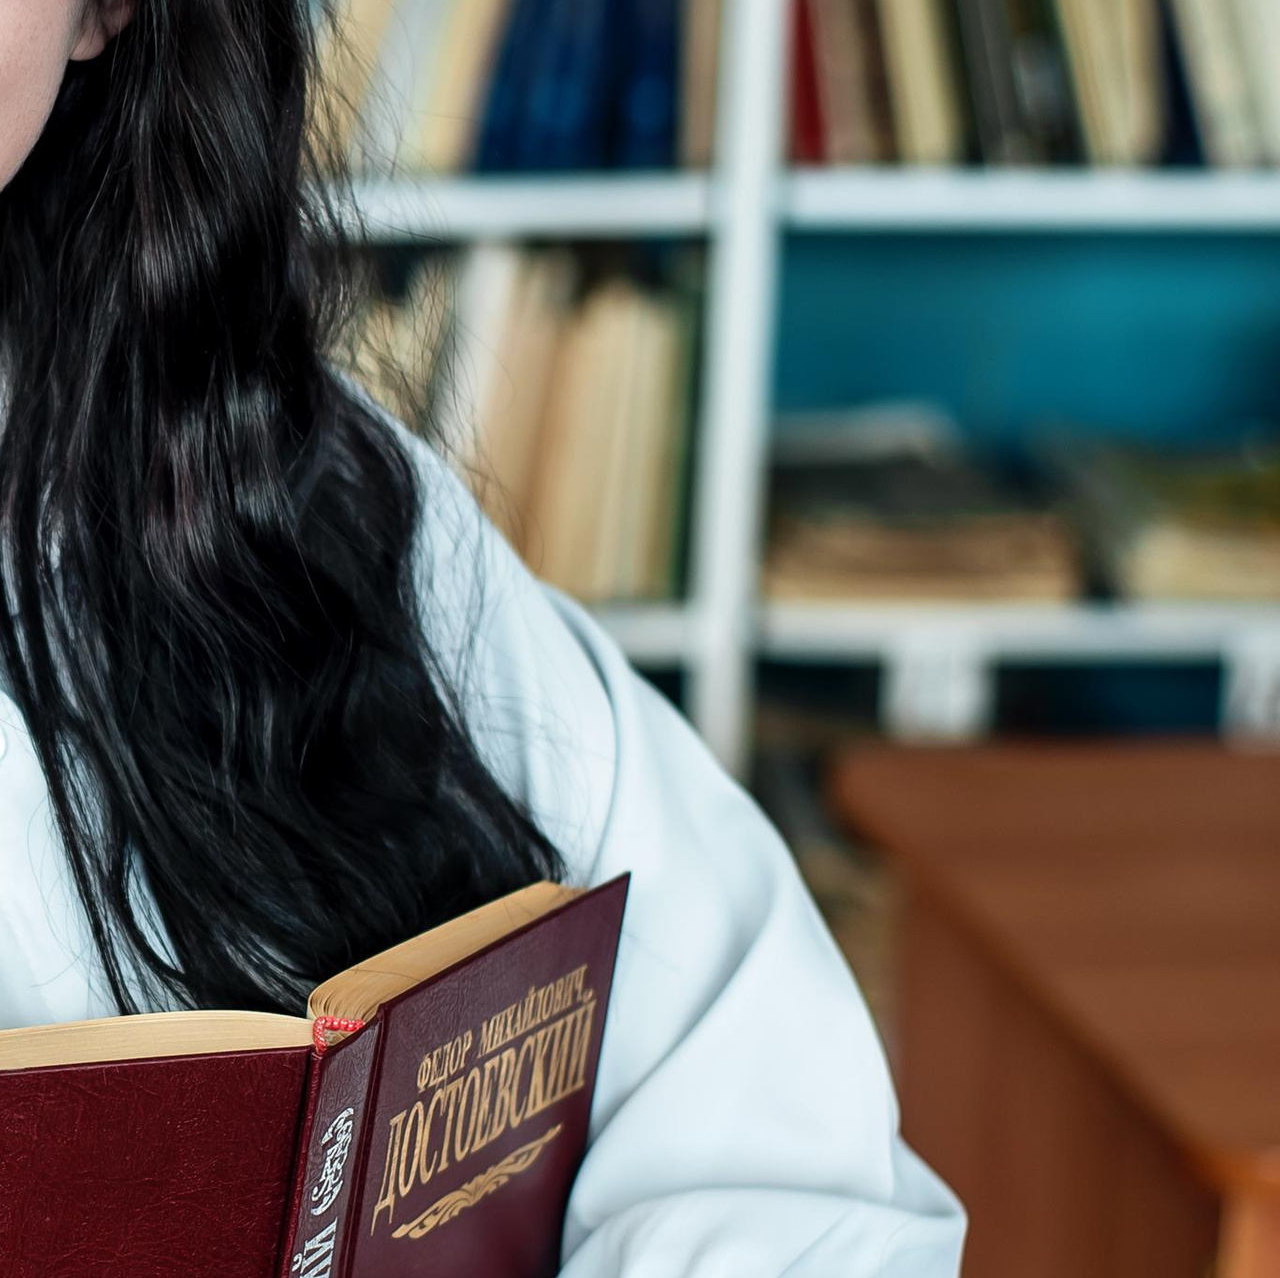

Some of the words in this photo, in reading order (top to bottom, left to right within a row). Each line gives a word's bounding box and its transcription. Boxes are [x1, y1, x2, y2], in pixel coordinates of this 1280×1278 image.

[371, 988, 596, 1236] ДОСТОЕВСКИЙ
[417, 1030, 472, 1094] ФЕДОР
[477, 964, 587, 1058] МИХАЙЛОВИЧ
